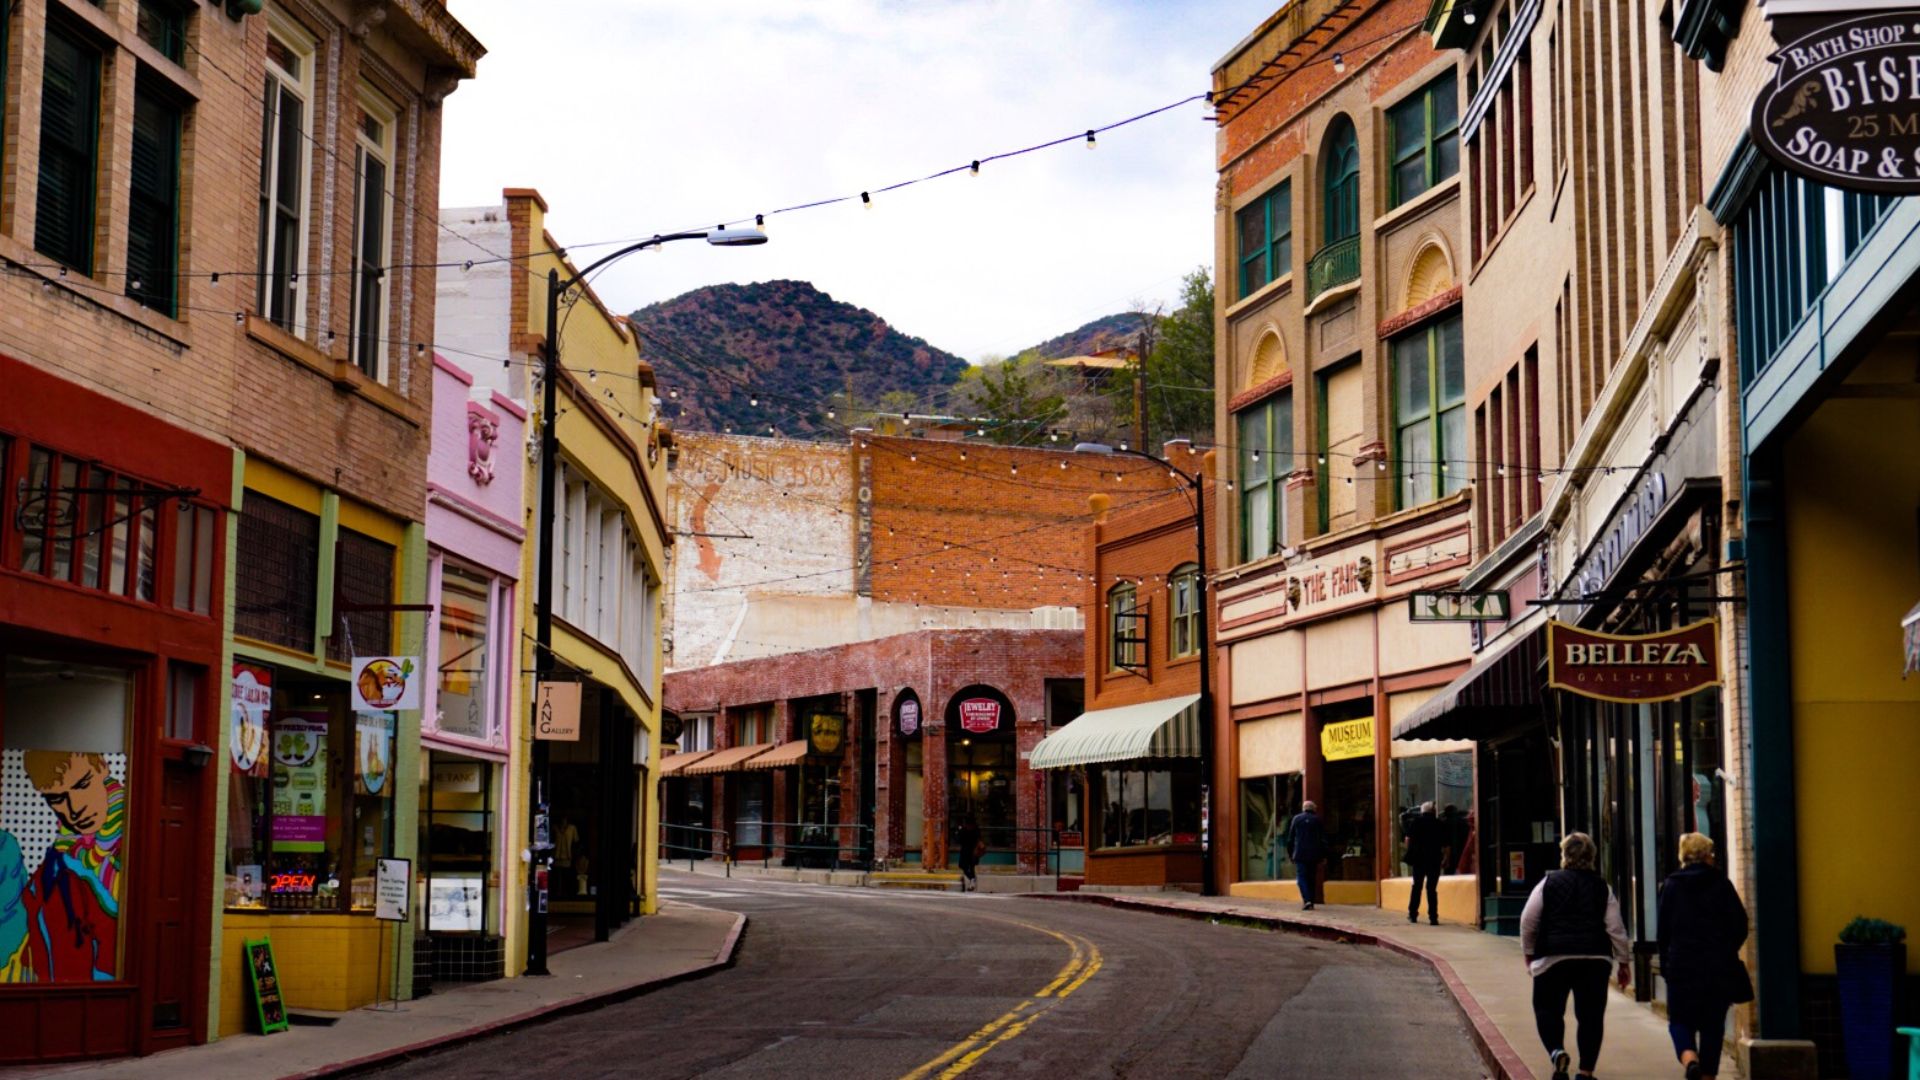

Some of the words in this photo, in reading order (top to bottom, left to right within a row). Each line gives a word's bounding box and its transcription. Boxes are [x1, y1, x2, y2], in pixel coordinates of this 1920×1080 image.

[1789, 35, 1846, 70] BATH
[1848, 25, 1906, 49] SHOP
[1848, 114, 1879, 138] 25
[1786, 126, 1869, 173] SOAP
[1877, 146, 1904, 178] &
[785, 457, 843, 488] BOX
[1303, 571, 1327, 605] THE
[1331, 561, 1359, 598] FAIR
[1414, 594, 1503, 617] ROKA
[1565, 642, 1708, 666] BELLEZA
[1577, 672, 1692, 682] GALLERY
[540, 686, 553, 734] TANG
[1328, 721, 1372, 743] MUSEUM
